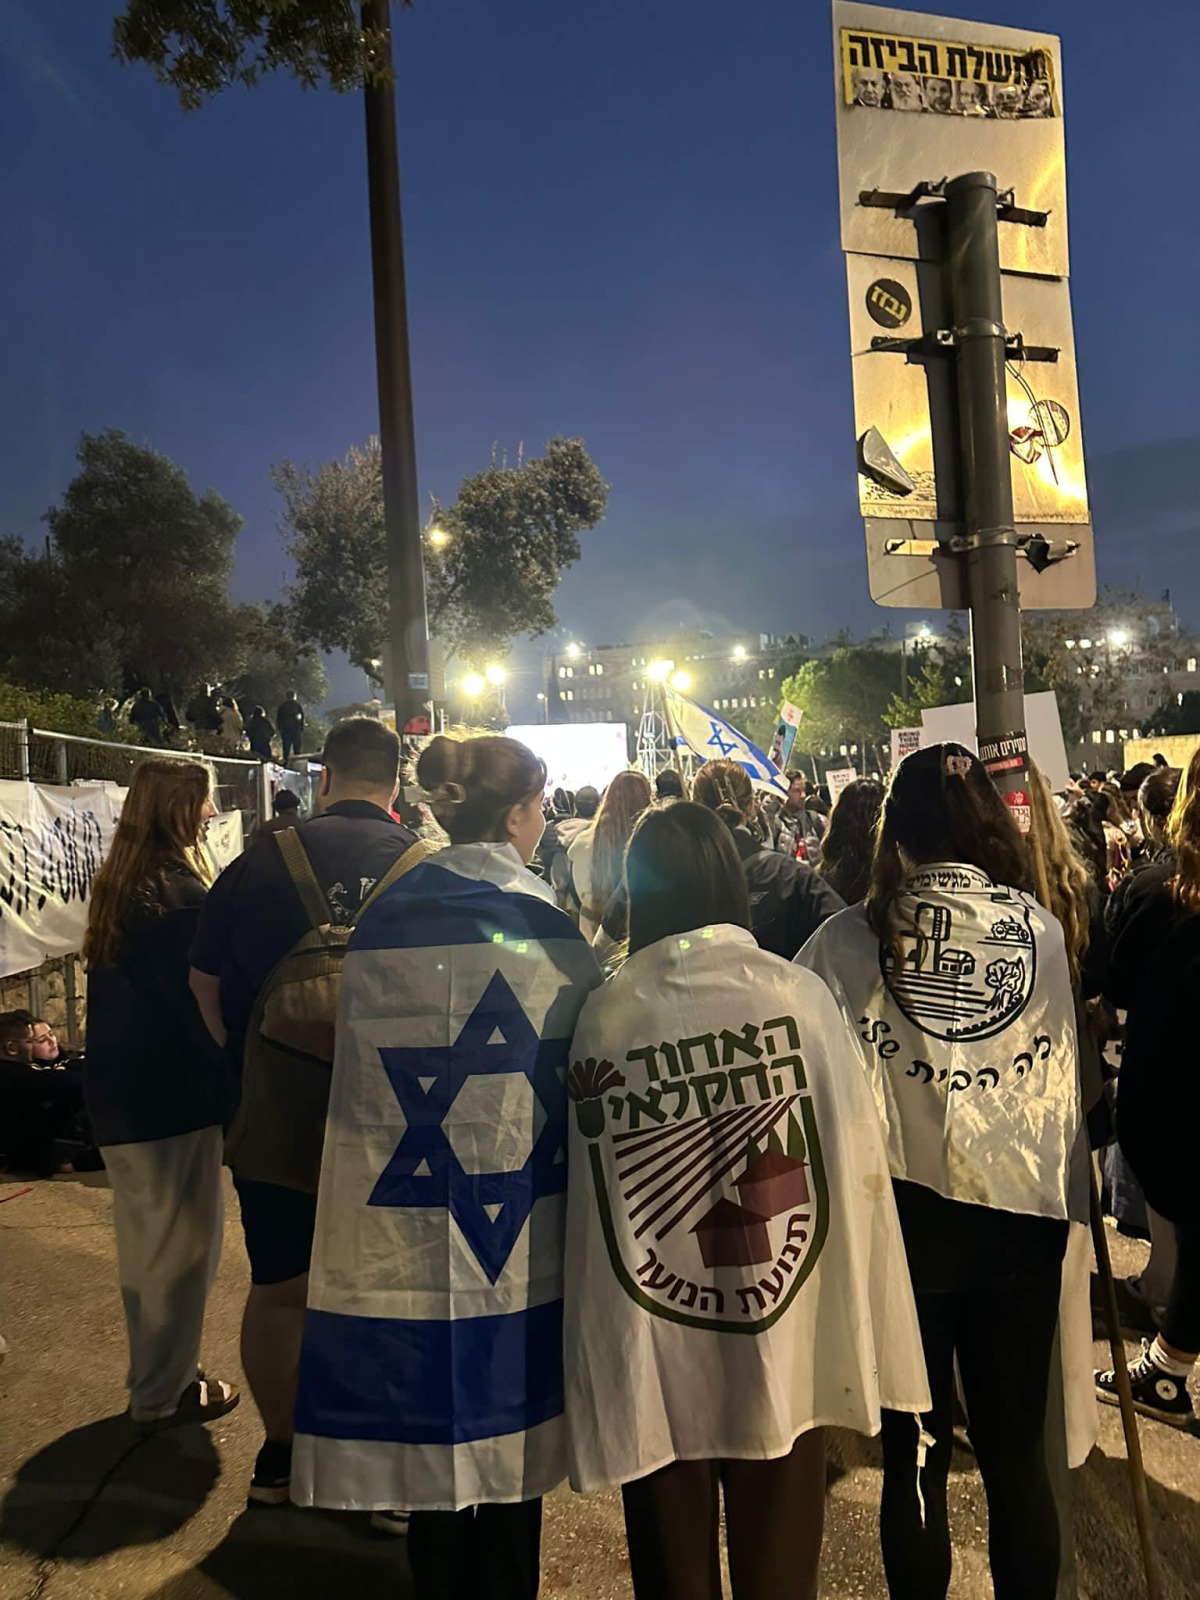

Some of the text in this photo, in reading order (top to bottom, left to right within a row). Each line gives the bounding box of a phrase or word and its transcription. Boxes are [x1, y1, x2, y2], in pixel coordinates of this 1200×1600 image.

[848, 35, 938, 75] הביזה
[608, 1054, 808, 1130] החקלאי
[857, 1016, 1051, 1092] מה הבית שלי
[636, 1213, 810, 1314] תנועת הנוער
